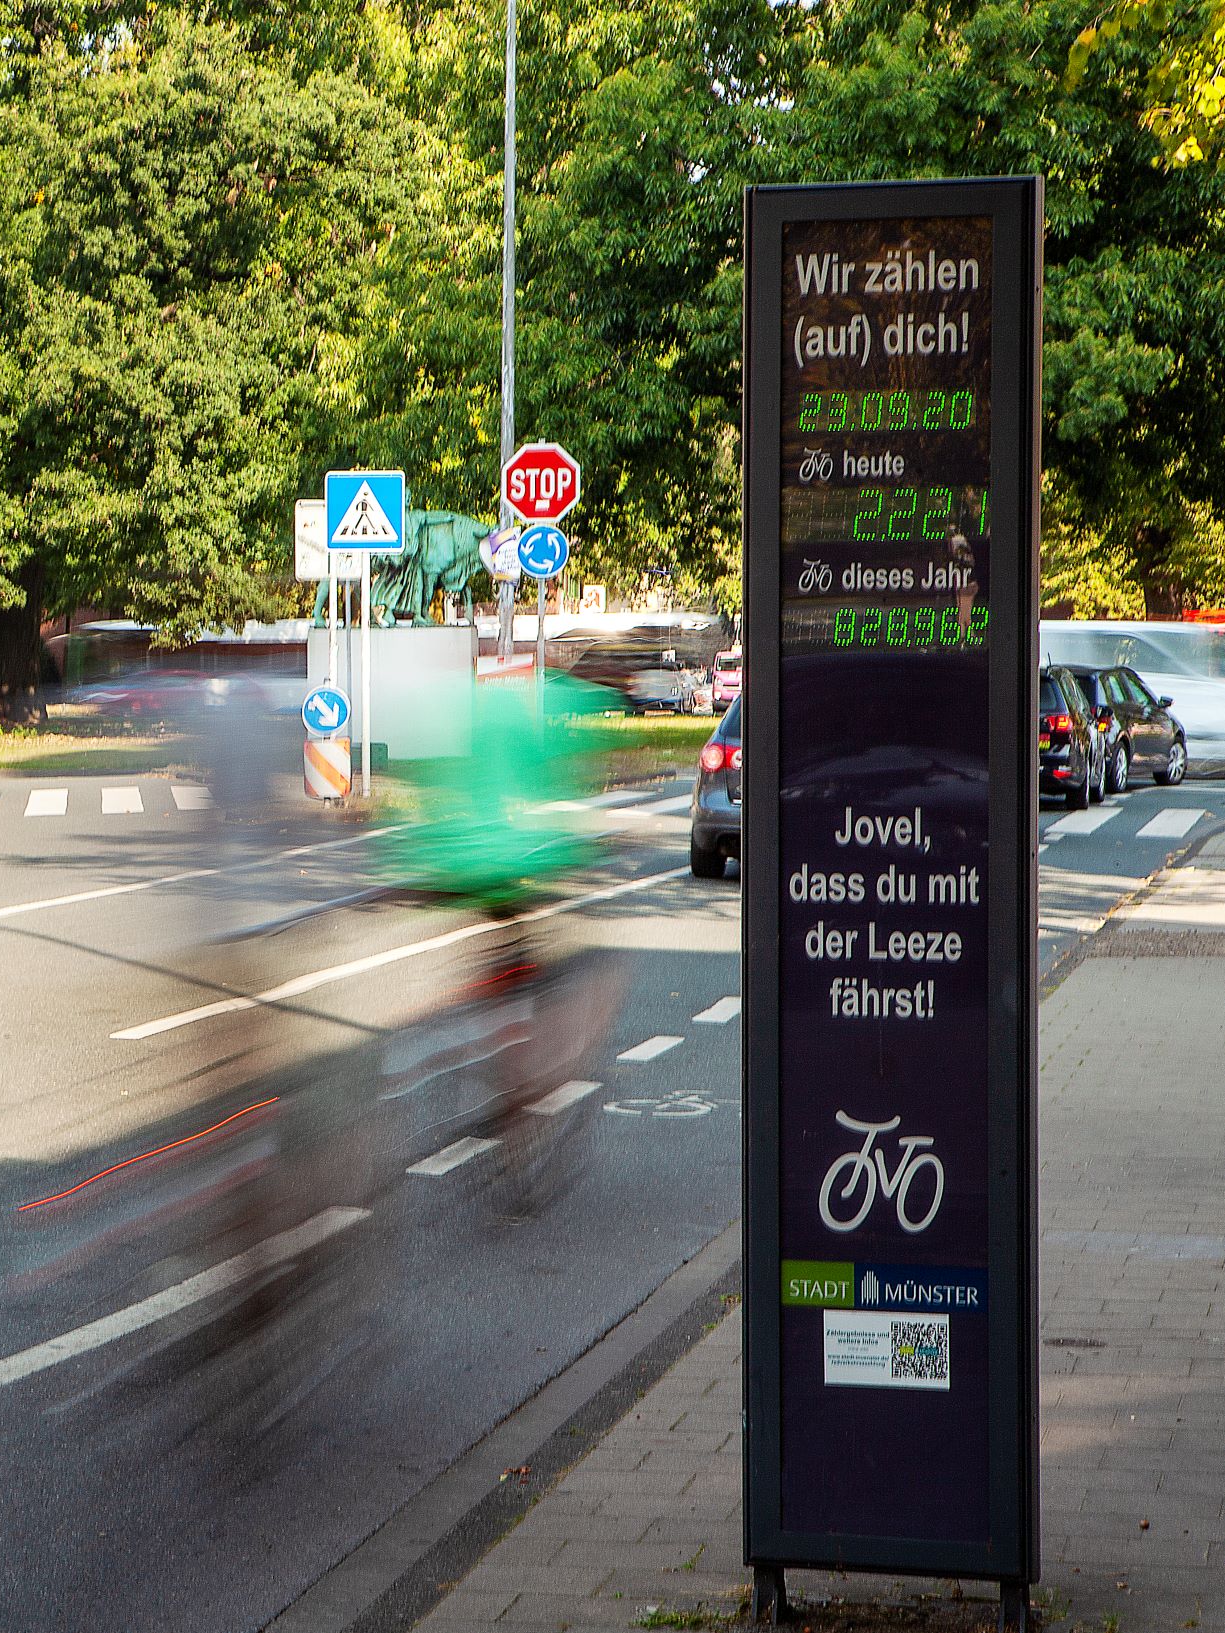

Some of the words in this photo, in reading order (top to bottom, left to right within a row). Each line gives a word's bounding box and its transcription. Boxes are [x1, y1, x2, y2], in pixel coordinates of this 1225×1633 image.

[795, 253, 855, 295] Wir
[864, 250, 979, 293] zählen
[794, 313, 871, 368] (auf)
[883, 311, 969, 355] dich!
[799, 391, 973, 432] 23.09.20
[843, 450, 905, 477] heute
[510, 468, 572, 501] STOP
[842, 562, 915, 590] dieses
[921, 561, 972, 589] Jahr
[835, 806, 931, 853] Jovel,
[789, 863, 865, 903] dass
[877, 864, 916, 903] du
[928, 865, 979, 904] mit
[805, 920, 858, 960] der
[869, 921, 962, 962] Leeze
[830, 977, 934, 1018] fährst!
[789, 1279, 849, 1299] STADT
[885, 1280, 978, 1305] MÜNSTER
